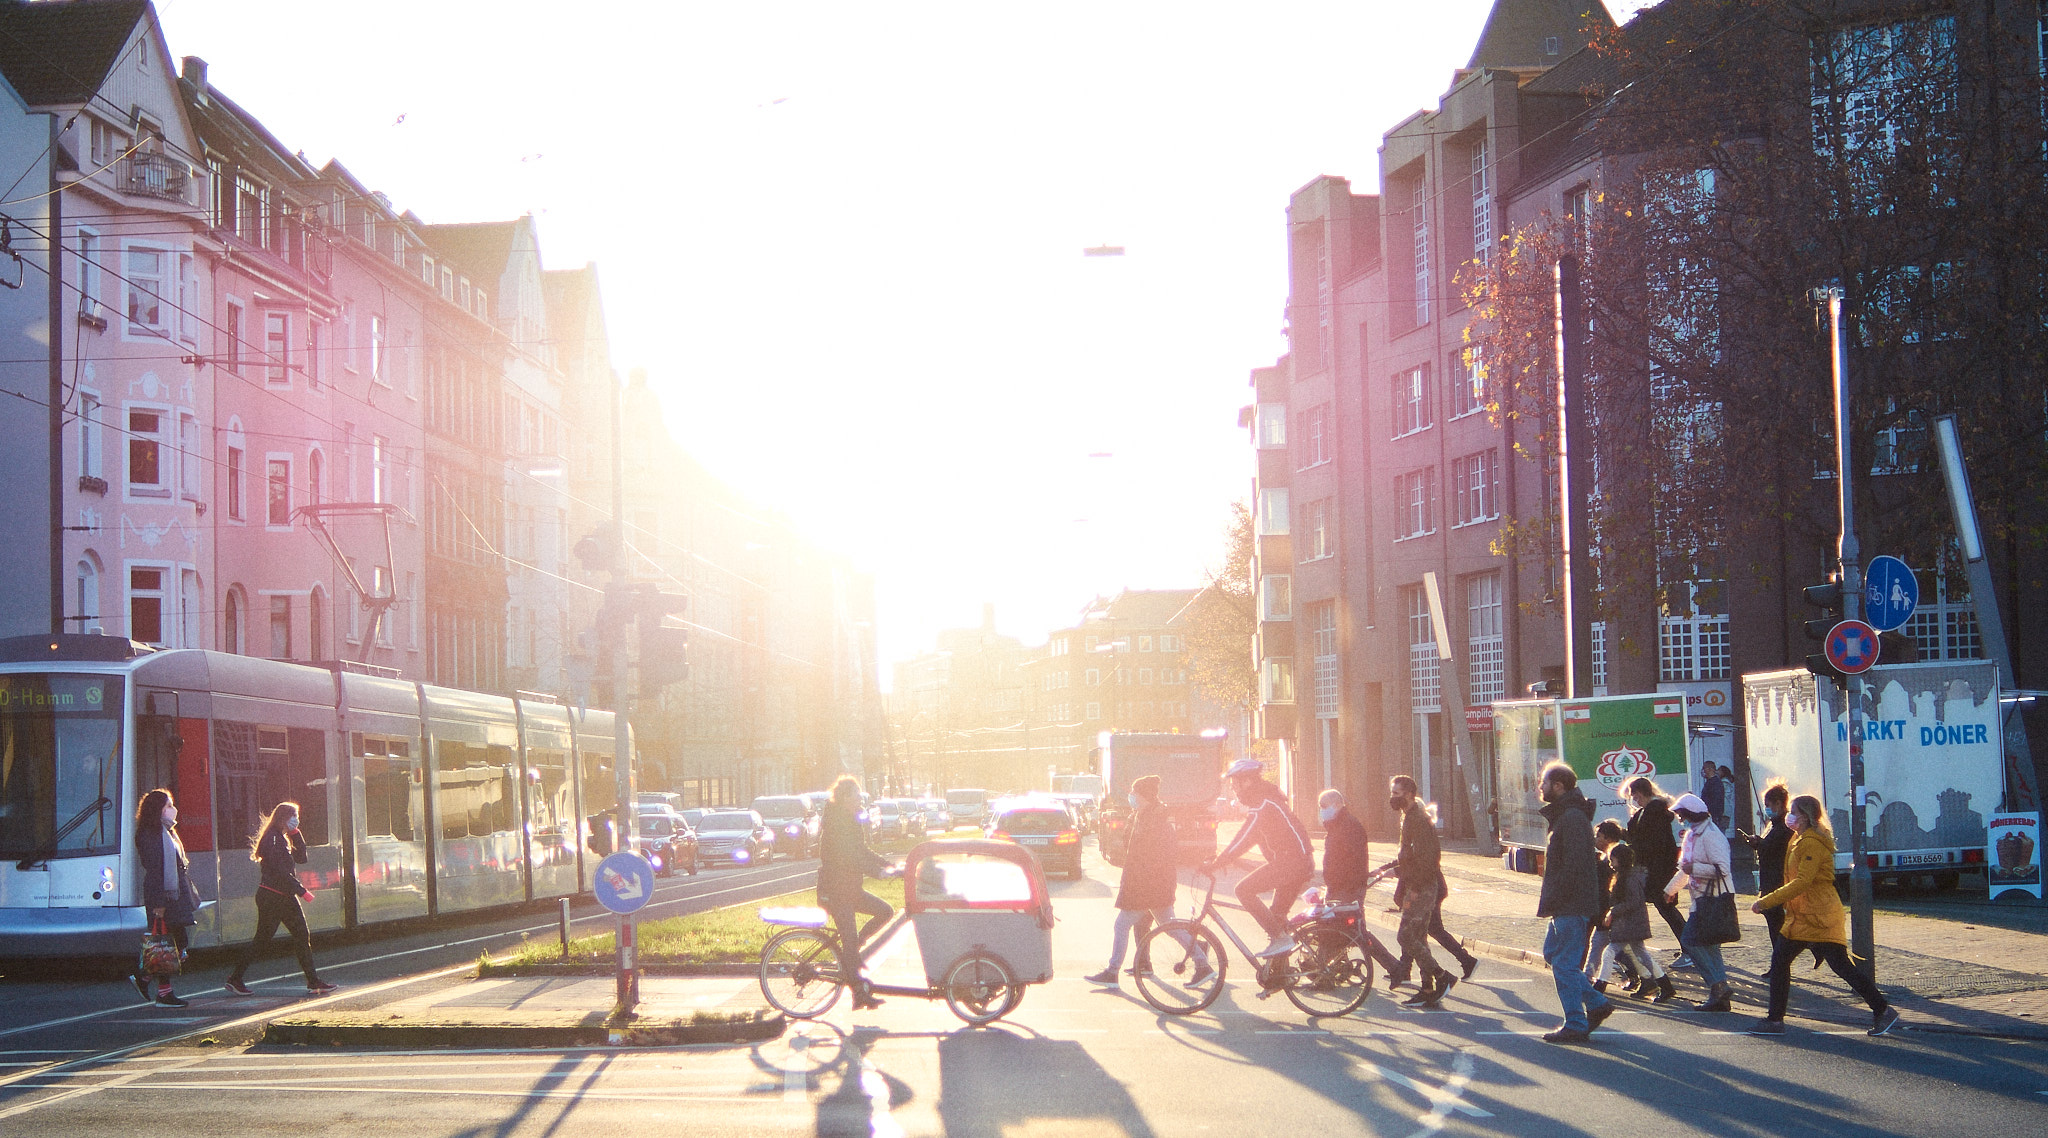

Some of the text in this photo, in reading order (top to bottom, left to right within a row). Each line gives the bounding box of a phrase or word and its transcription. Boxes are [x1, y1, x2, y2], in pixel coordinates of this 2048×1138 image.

[0, 688, 74, 706] D-Hamm
[1465, 708, 1493, 721] amplifo
[1837, 720, 1907, 742] MRKT
[1920, 722, 1988, 746] DÖNER
